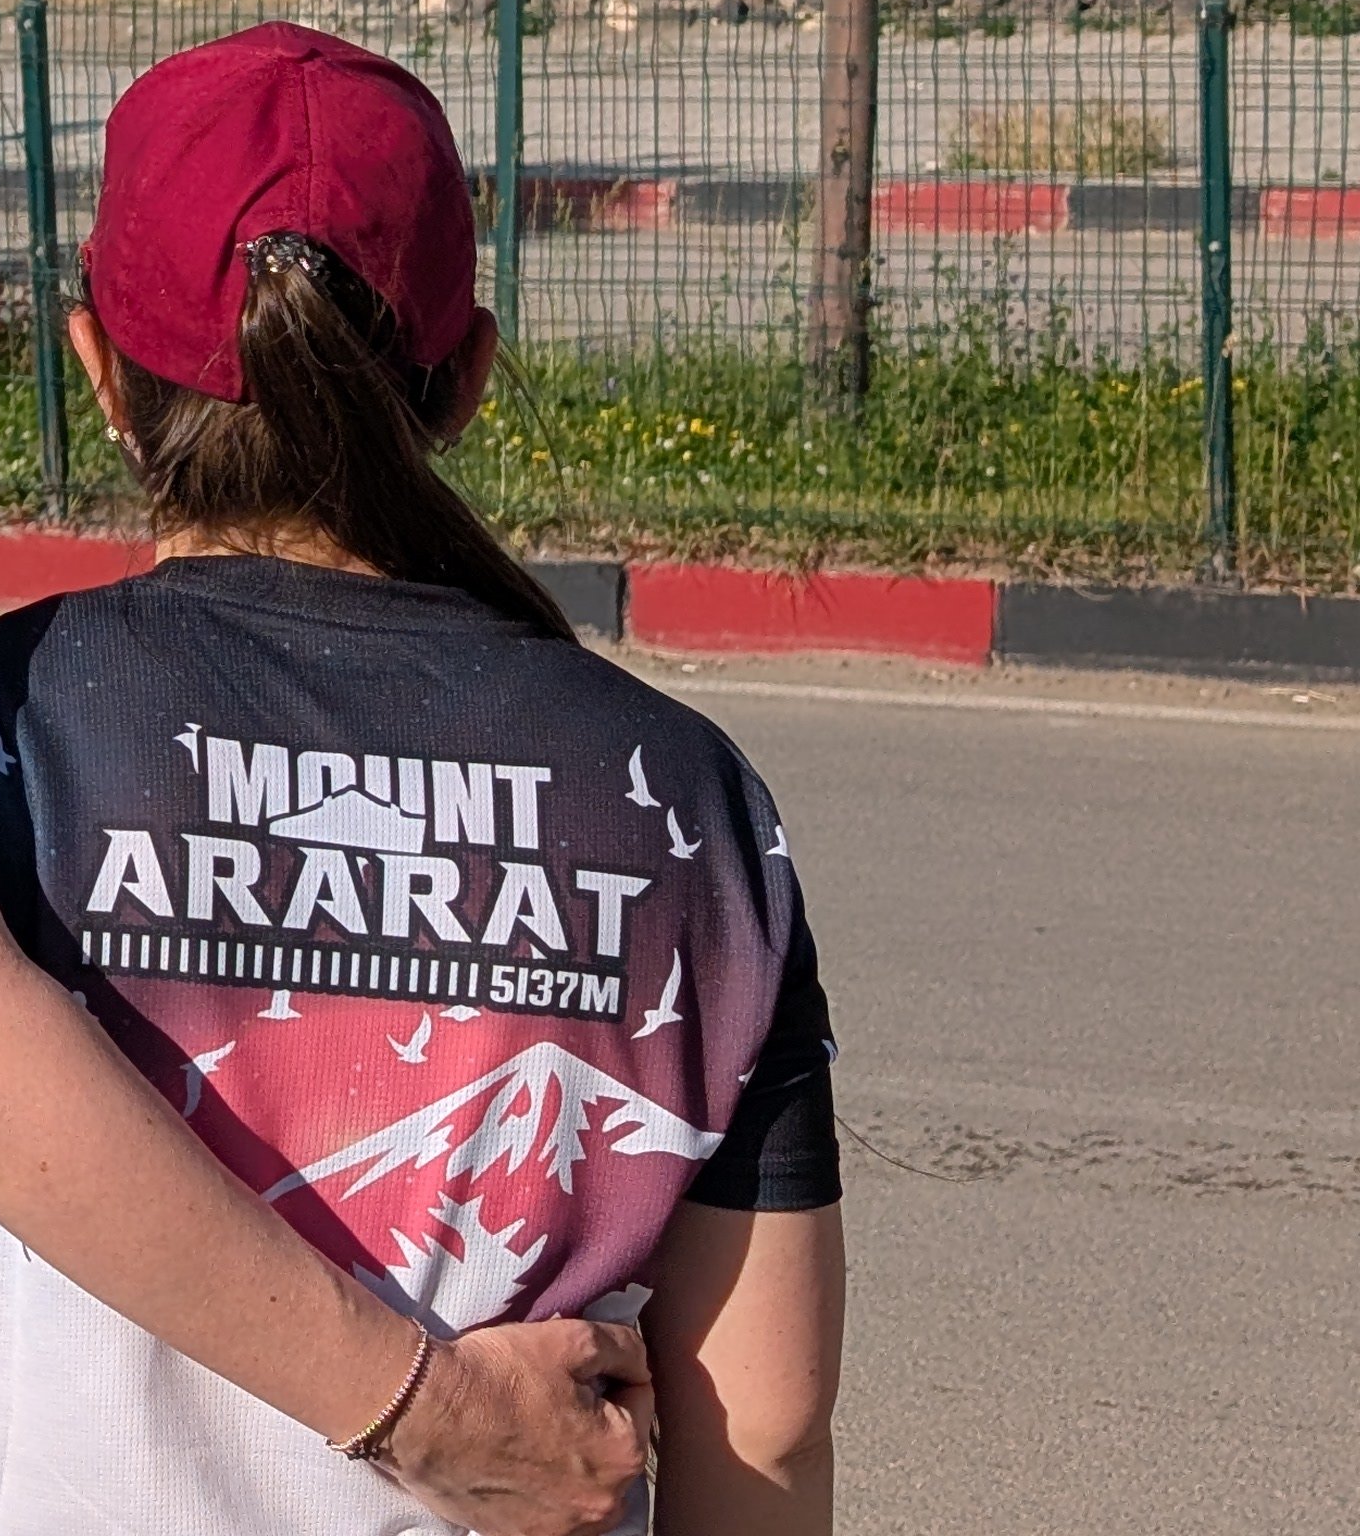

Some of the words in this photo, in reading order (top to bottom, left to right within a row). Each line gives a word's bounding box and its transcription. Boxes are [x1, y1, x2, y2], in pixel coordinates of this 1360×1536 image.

[205, 736, 551, 850] MOUNT
[86, 828, 652, 958] ARARAT
[489, 966, 619, 1015] 5137M
